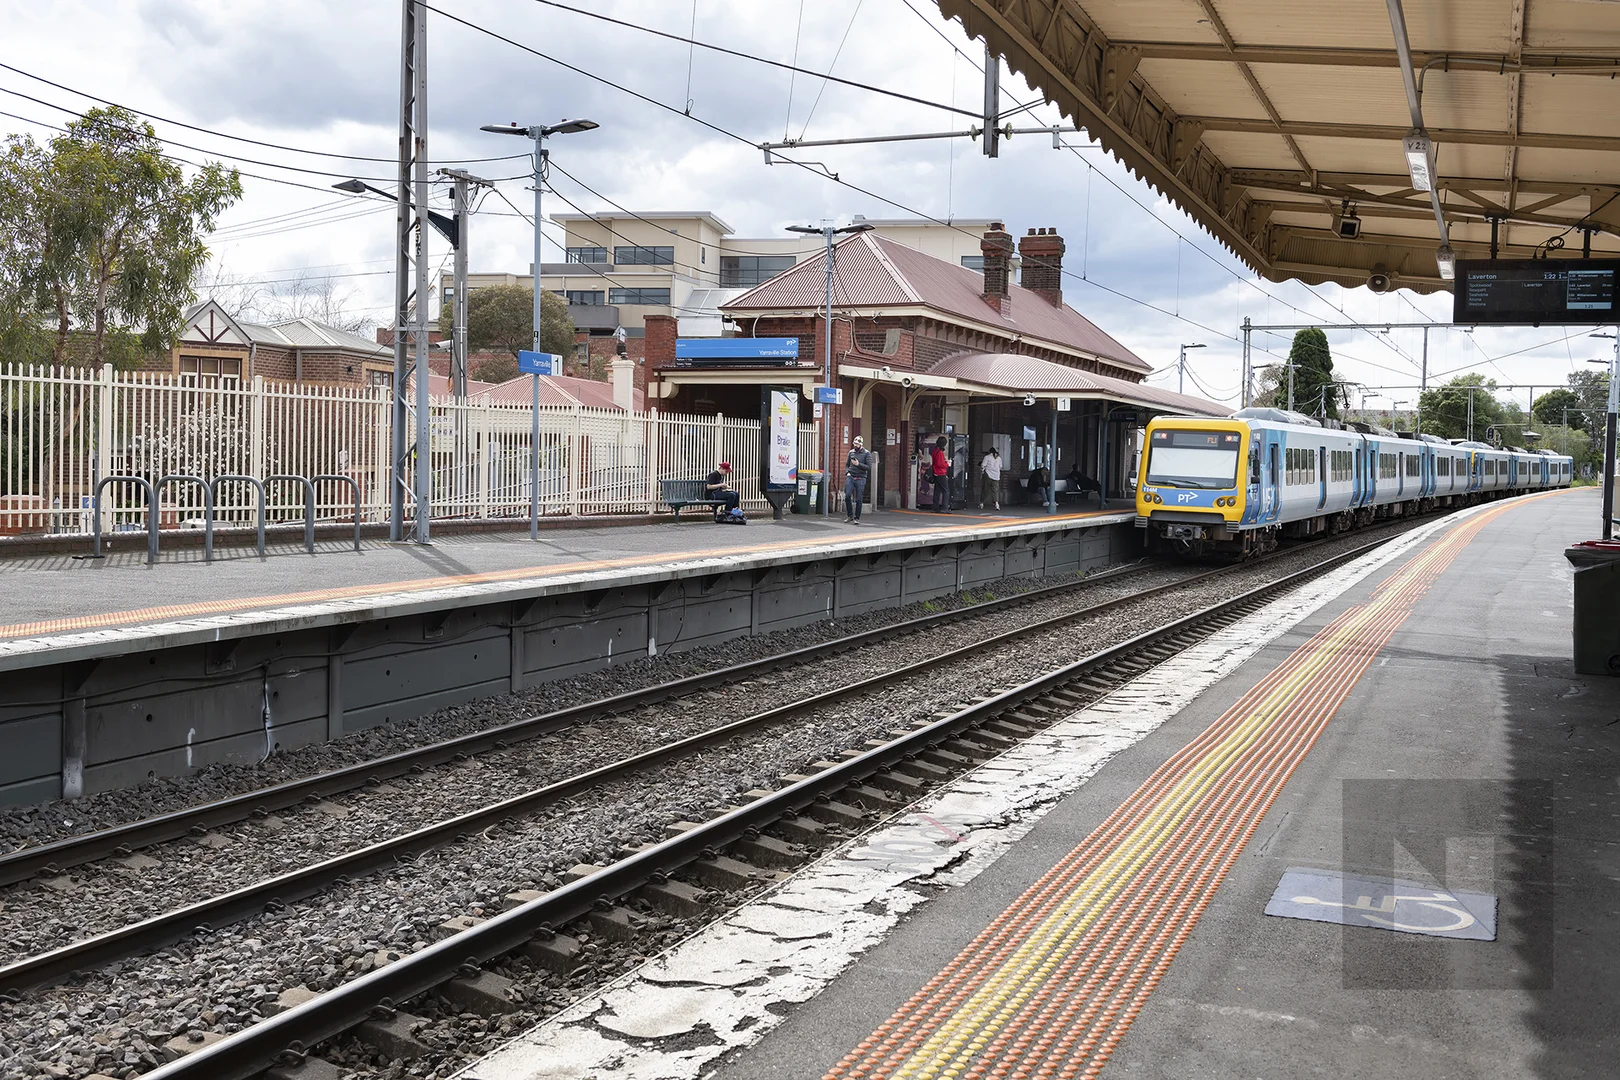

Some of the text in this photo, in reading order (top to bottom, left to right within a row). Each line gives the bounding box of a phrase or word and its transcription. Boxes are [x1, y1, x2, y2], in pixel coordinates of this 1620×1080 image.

[555, 358, 559, 374] 1
[1062, 399, 1066, 409] 1
[778, 453, 790, 465] Hold
